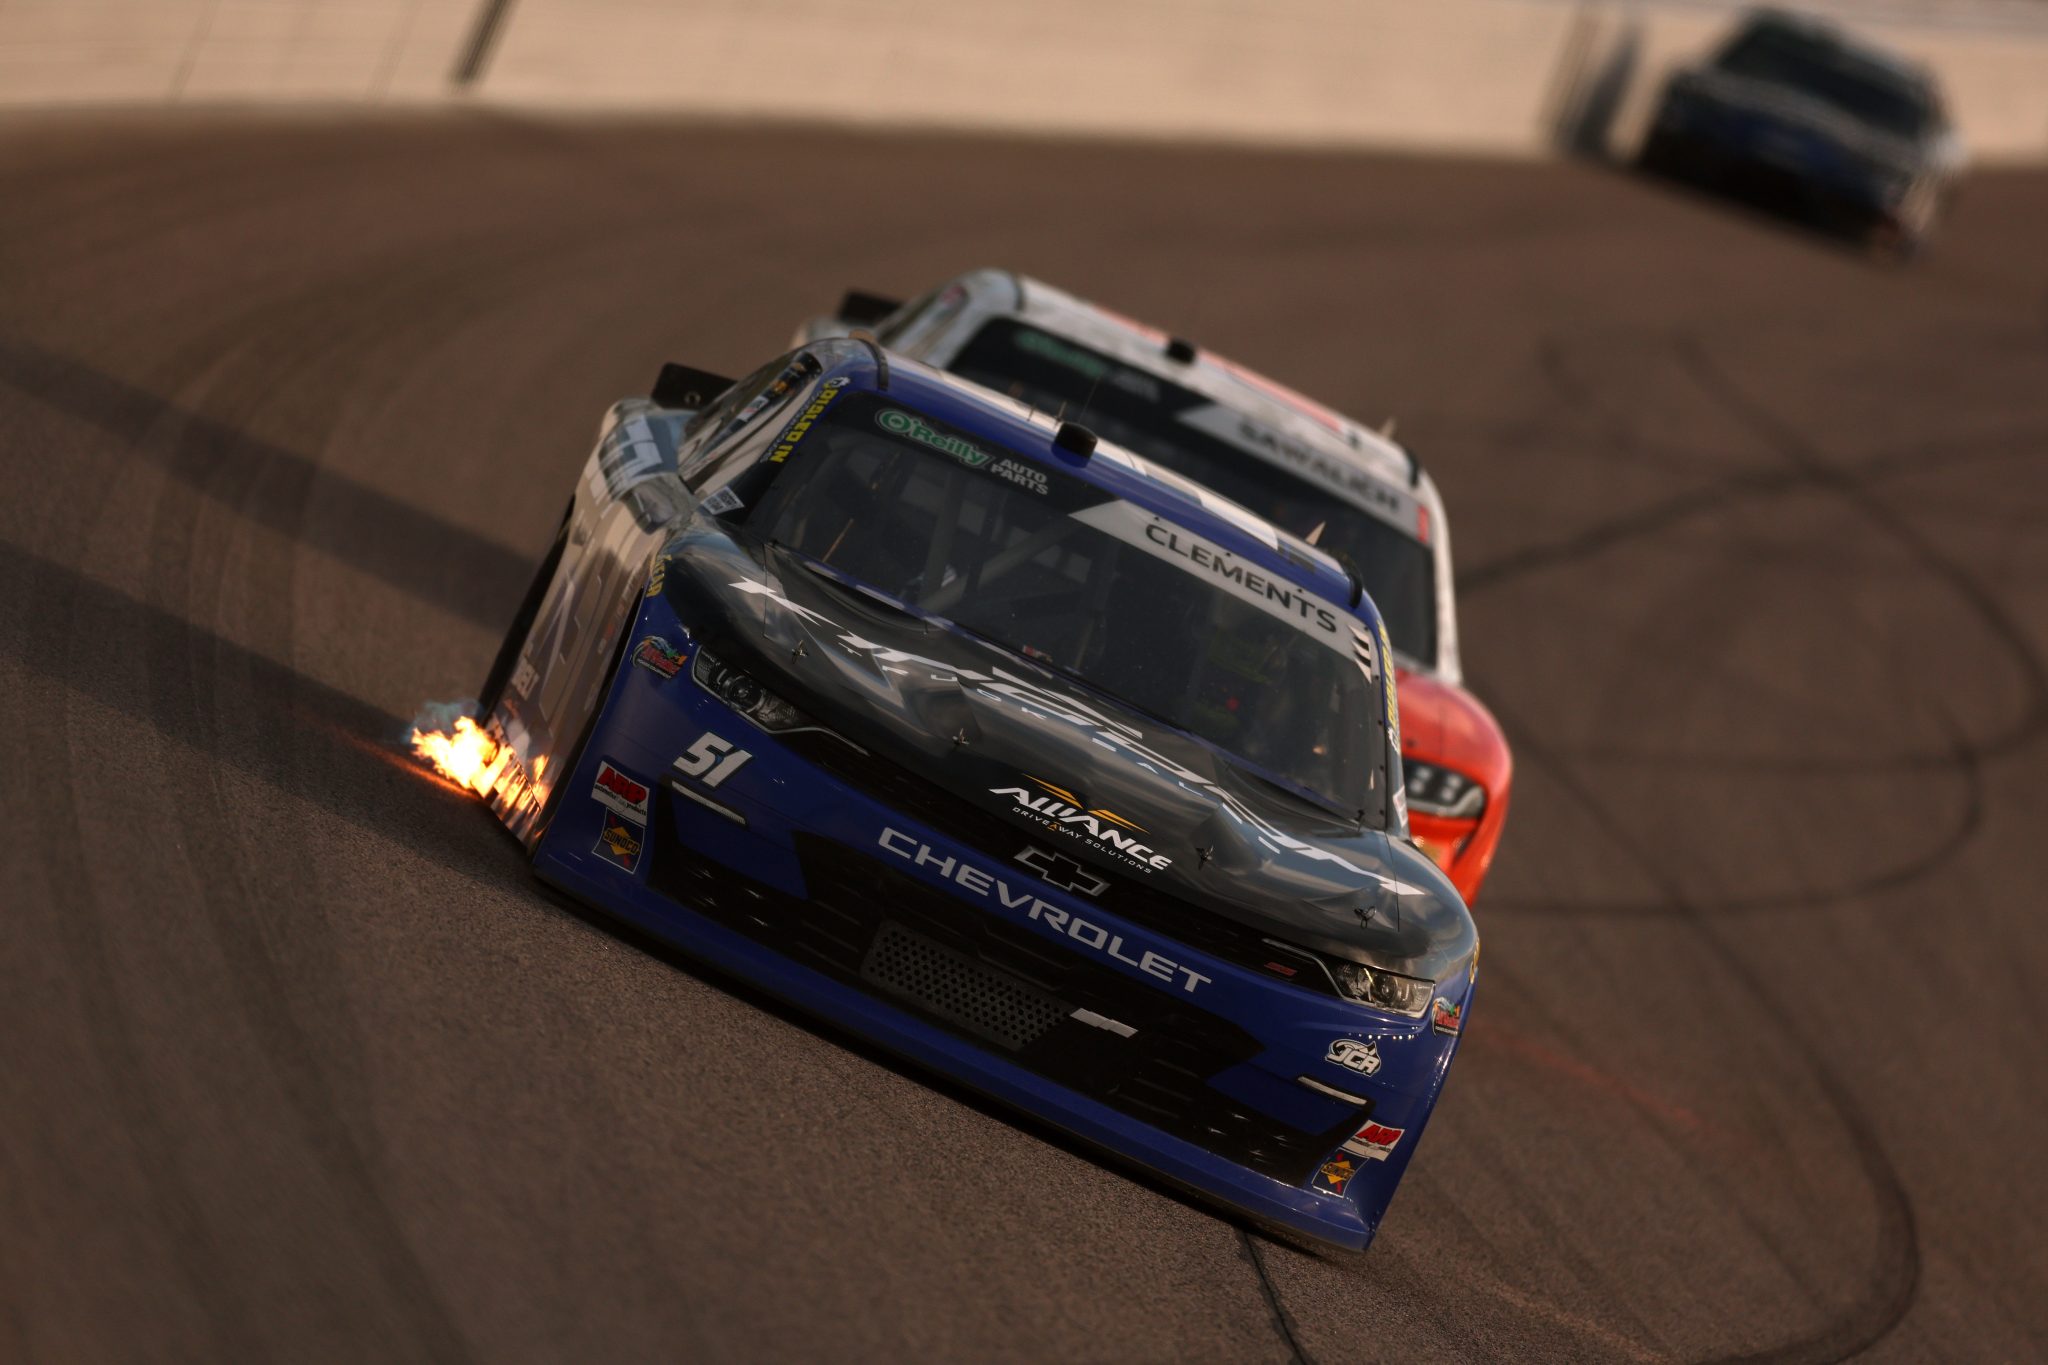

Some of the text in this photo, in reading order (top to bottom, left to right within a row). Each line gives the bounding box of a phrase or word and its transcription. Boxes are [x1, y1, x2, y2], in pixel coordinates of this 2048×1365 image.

[877, 408, 992, 468] O'Reilly
[991, 464, 1049, 495] PARTS
[1000, 458, 1048, 483] AUTO
[1145, 523, 1337, 634] CLEMENTS
[597, 766, 647, 805] ARP
[673, 731, 753, 788] 51
[603, 828, 640, 855] SUNOCO
[988, 787, 1172, 871] ALLIANCE
[1012, 806, 1153, 874] DRIVEAWAY SOLUTIONS
[878, 827, 1212, 993] CHEVROLET
